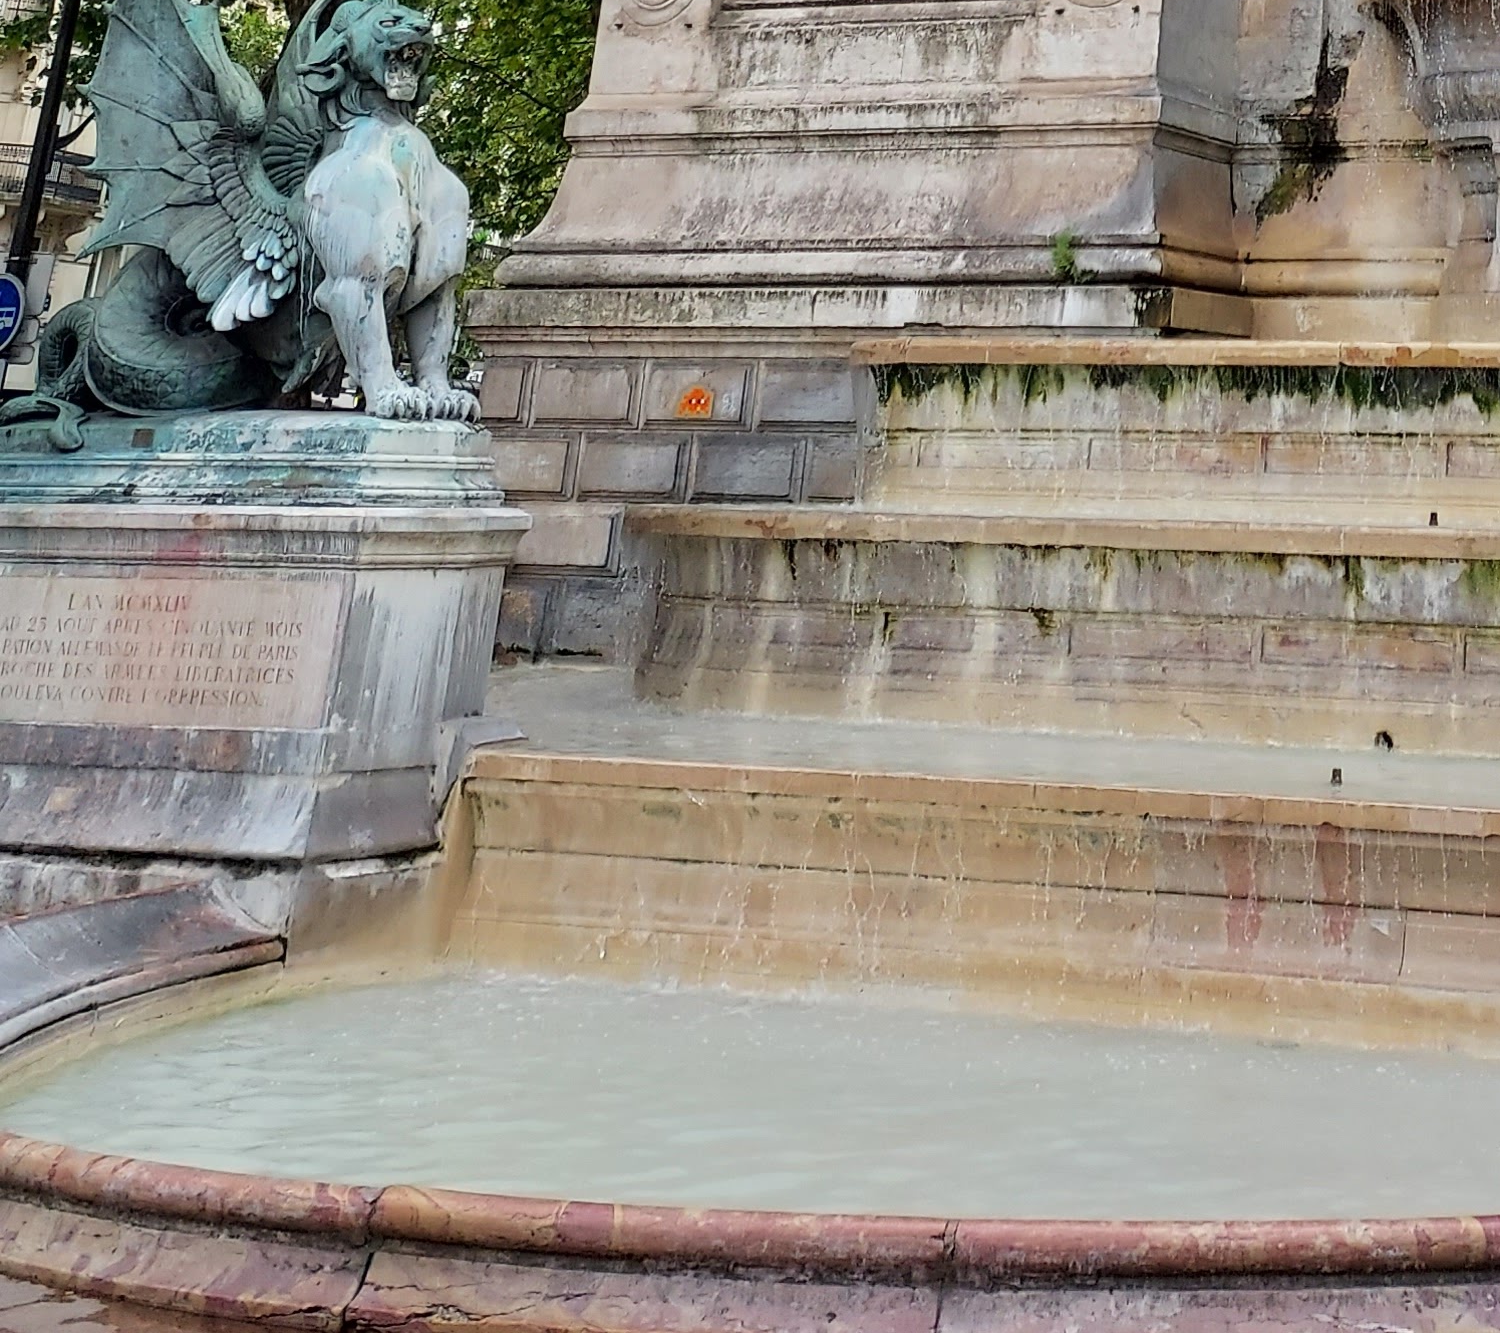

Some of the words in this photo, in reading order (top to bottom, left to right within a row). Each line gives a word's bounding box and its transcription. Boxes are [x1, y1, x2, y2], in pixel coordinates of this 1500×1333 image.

[27, 617, 47, 631] 25
[265, 622, 303, 637] MOIS
[232, 644, 252, 659] DE
[258, 645, 298, 660] PARIS
[63, 663, 94, 678] DES
[71, 686, 133, 703] CONTRE
